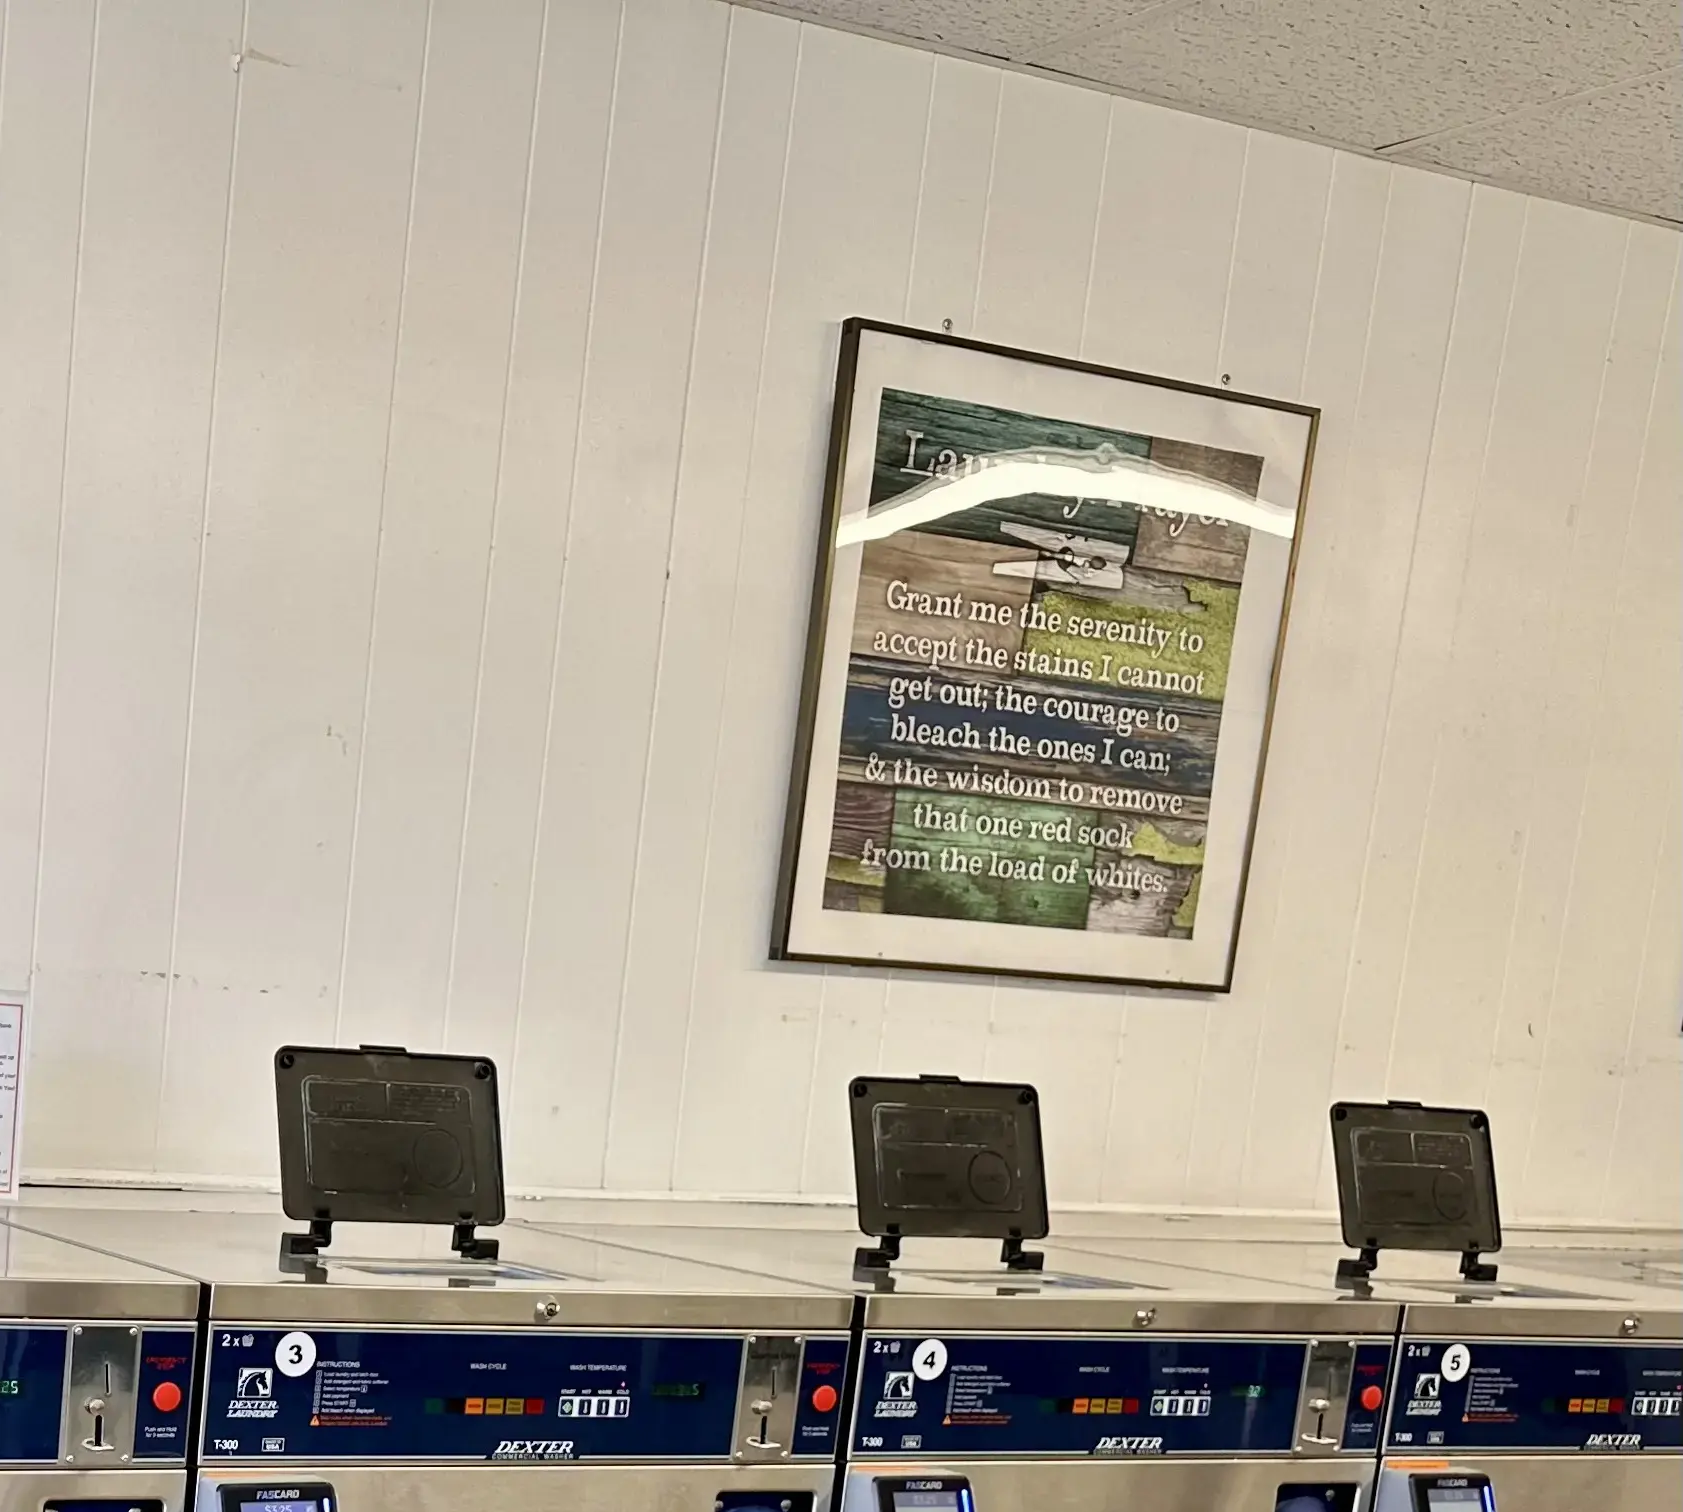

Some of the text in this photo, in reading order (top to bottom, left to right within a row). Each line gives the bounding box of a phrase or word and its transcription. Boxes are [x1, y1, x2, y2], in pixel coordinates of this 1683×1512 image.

[886, 579, 1203, 658] Grant me the serenity to
[873, 631, 1205, 695] accept the stains I cannot
[888, 676, 1180, 737] get out; the courage to
[890, 714, 1171, 773] bleach the ones I can;
[864, 752, 1183, 815] & the wisdom to remove
[913, 803, 1133, 849] that one red sock
[860, 838, 1168, 895] from the load of whites.
[221, 1334, 231, 1347] 2
[289, 1344, 303, 1364] 3
[922, 1351, 936, 1369] 4
[1450, 1354, 1461, 1371] 5
[228, 1400, 278, 1409] DEXTER
[214, 1439, 238, 1449] T-300
[494, 1441, 574, 1454] DEXTER
[862, 1437, 883, 1446] T-300
[1095, 1437, 1163, 1449] DEXTER
[1586, 1434, 1641, 1444] DEXTER
[256, 1489, 300, 1499] FASCARD
